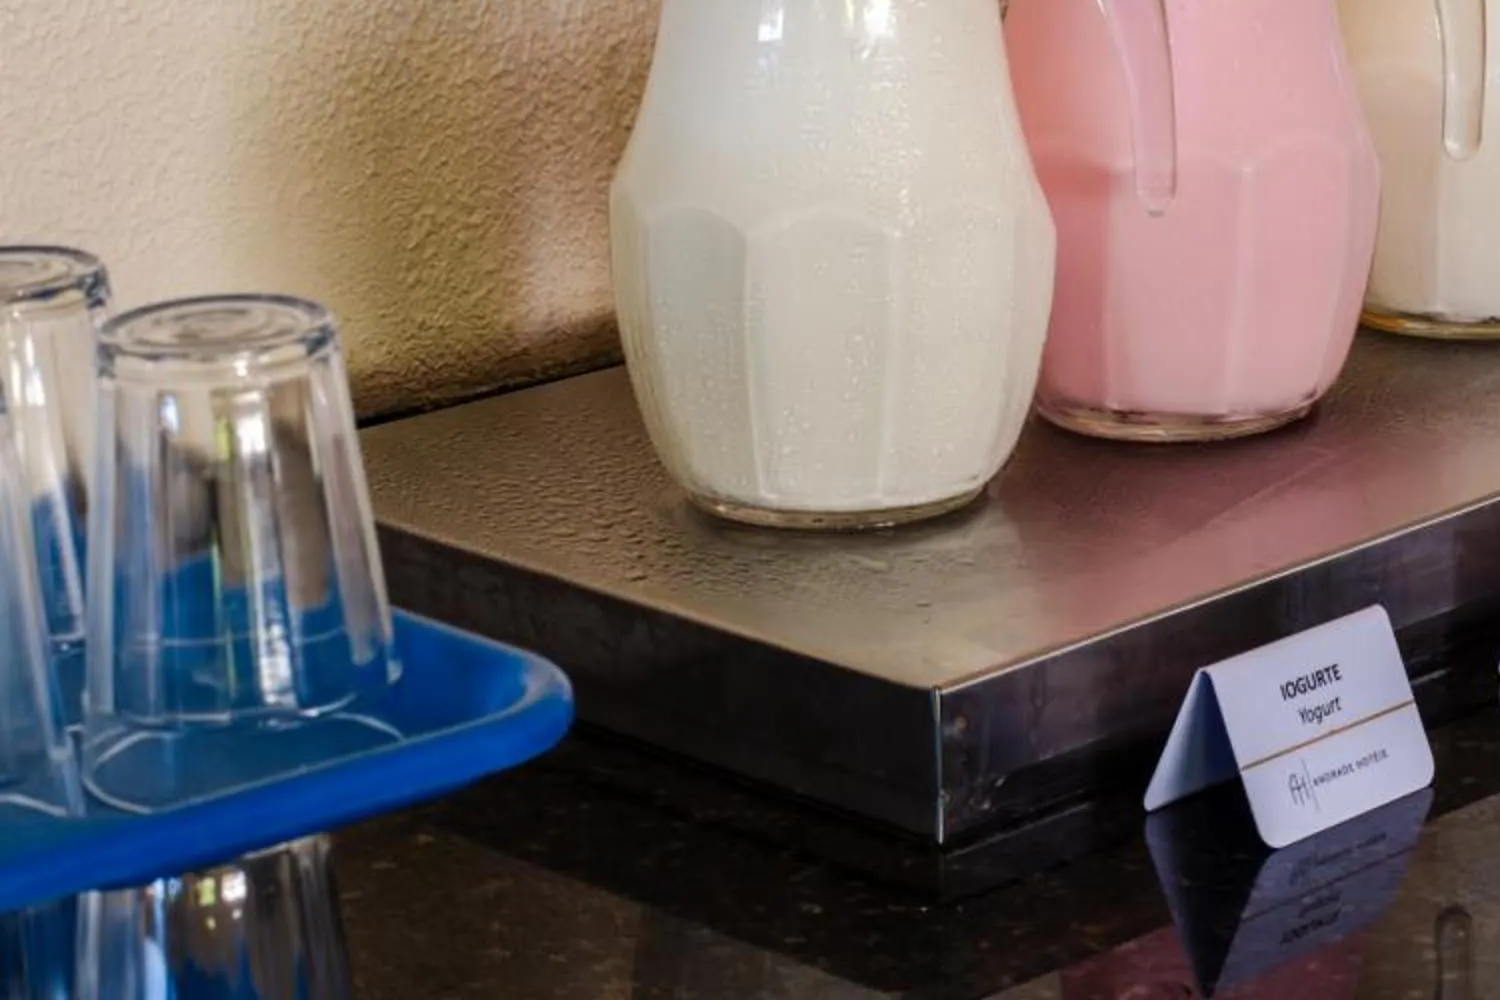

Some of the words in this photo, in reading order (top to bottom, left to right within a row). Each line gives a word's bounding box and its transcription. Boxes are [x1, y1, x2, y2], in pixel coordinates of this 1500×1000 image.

[1280, 663, 1342, 701] IOGURTE
[1298, 696, 1342, 725] Yogurt
[1313, 763, 1355, 787] ANDRADE
